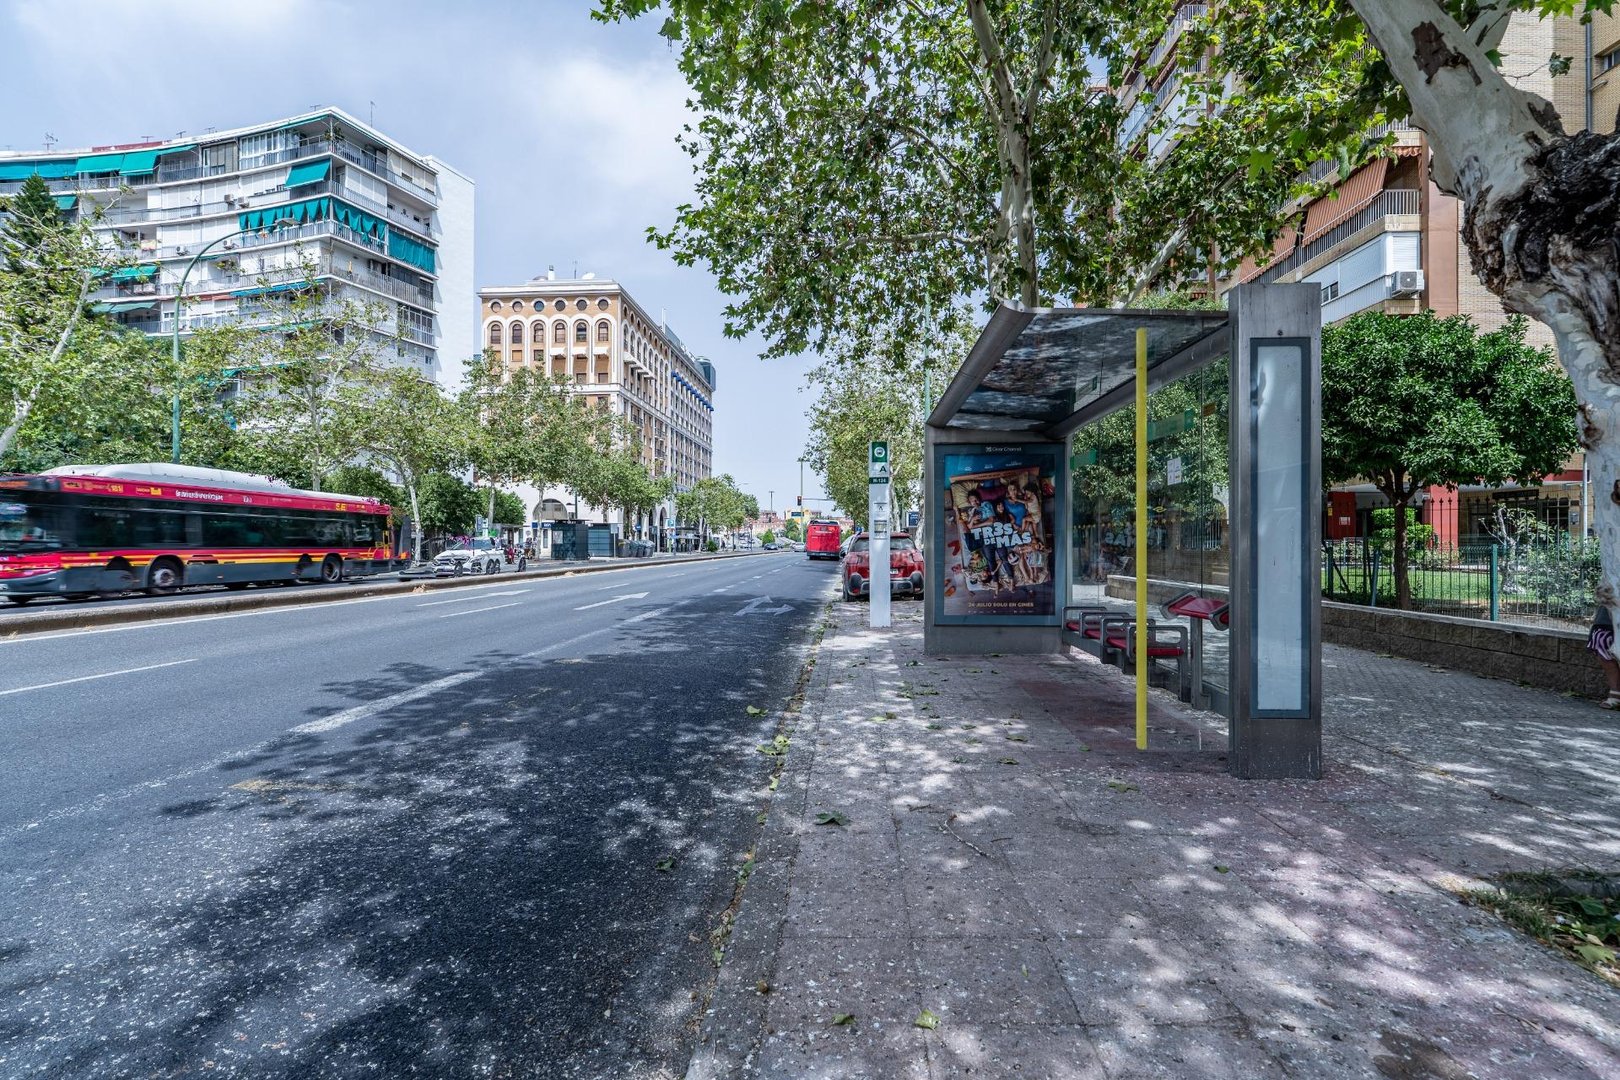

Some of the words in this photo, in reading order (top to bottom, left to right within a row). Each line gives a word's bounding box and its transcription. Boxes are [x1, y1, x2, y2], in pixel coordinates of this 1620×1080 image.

[970, 522, 1013, 540] TR3S
[983, 537, 996, 546] DE
[995, 530, 1032, 548] MÁS
